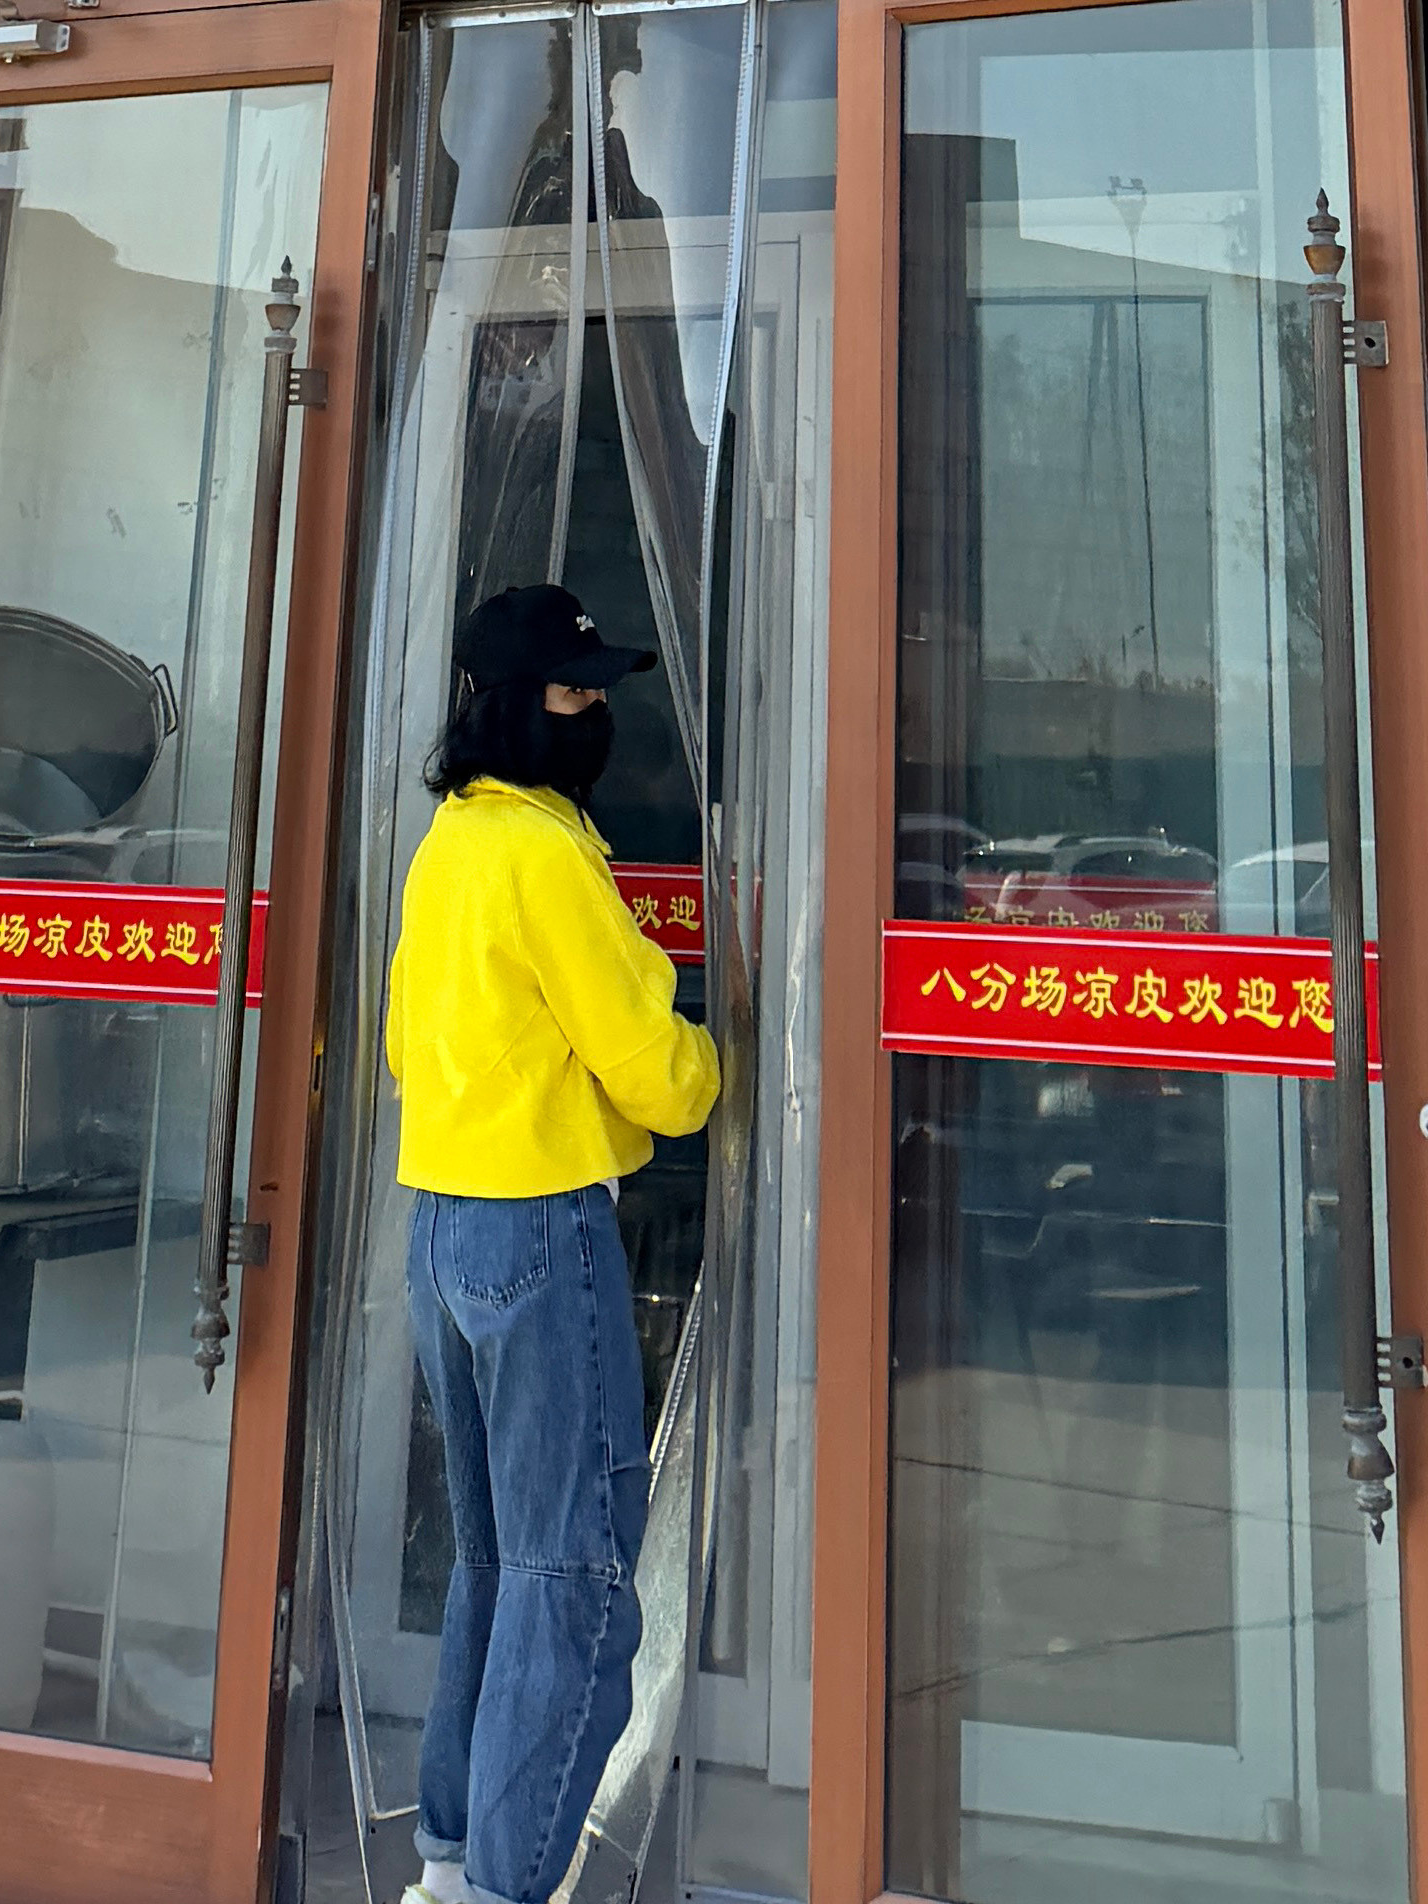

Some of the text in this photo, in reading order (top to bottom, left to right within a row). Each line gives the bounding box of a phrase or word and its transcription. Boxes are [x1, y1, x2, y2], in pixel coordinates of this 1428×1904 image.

[920, 961, 1335, 1034] 八分场凉皮欢迎您
